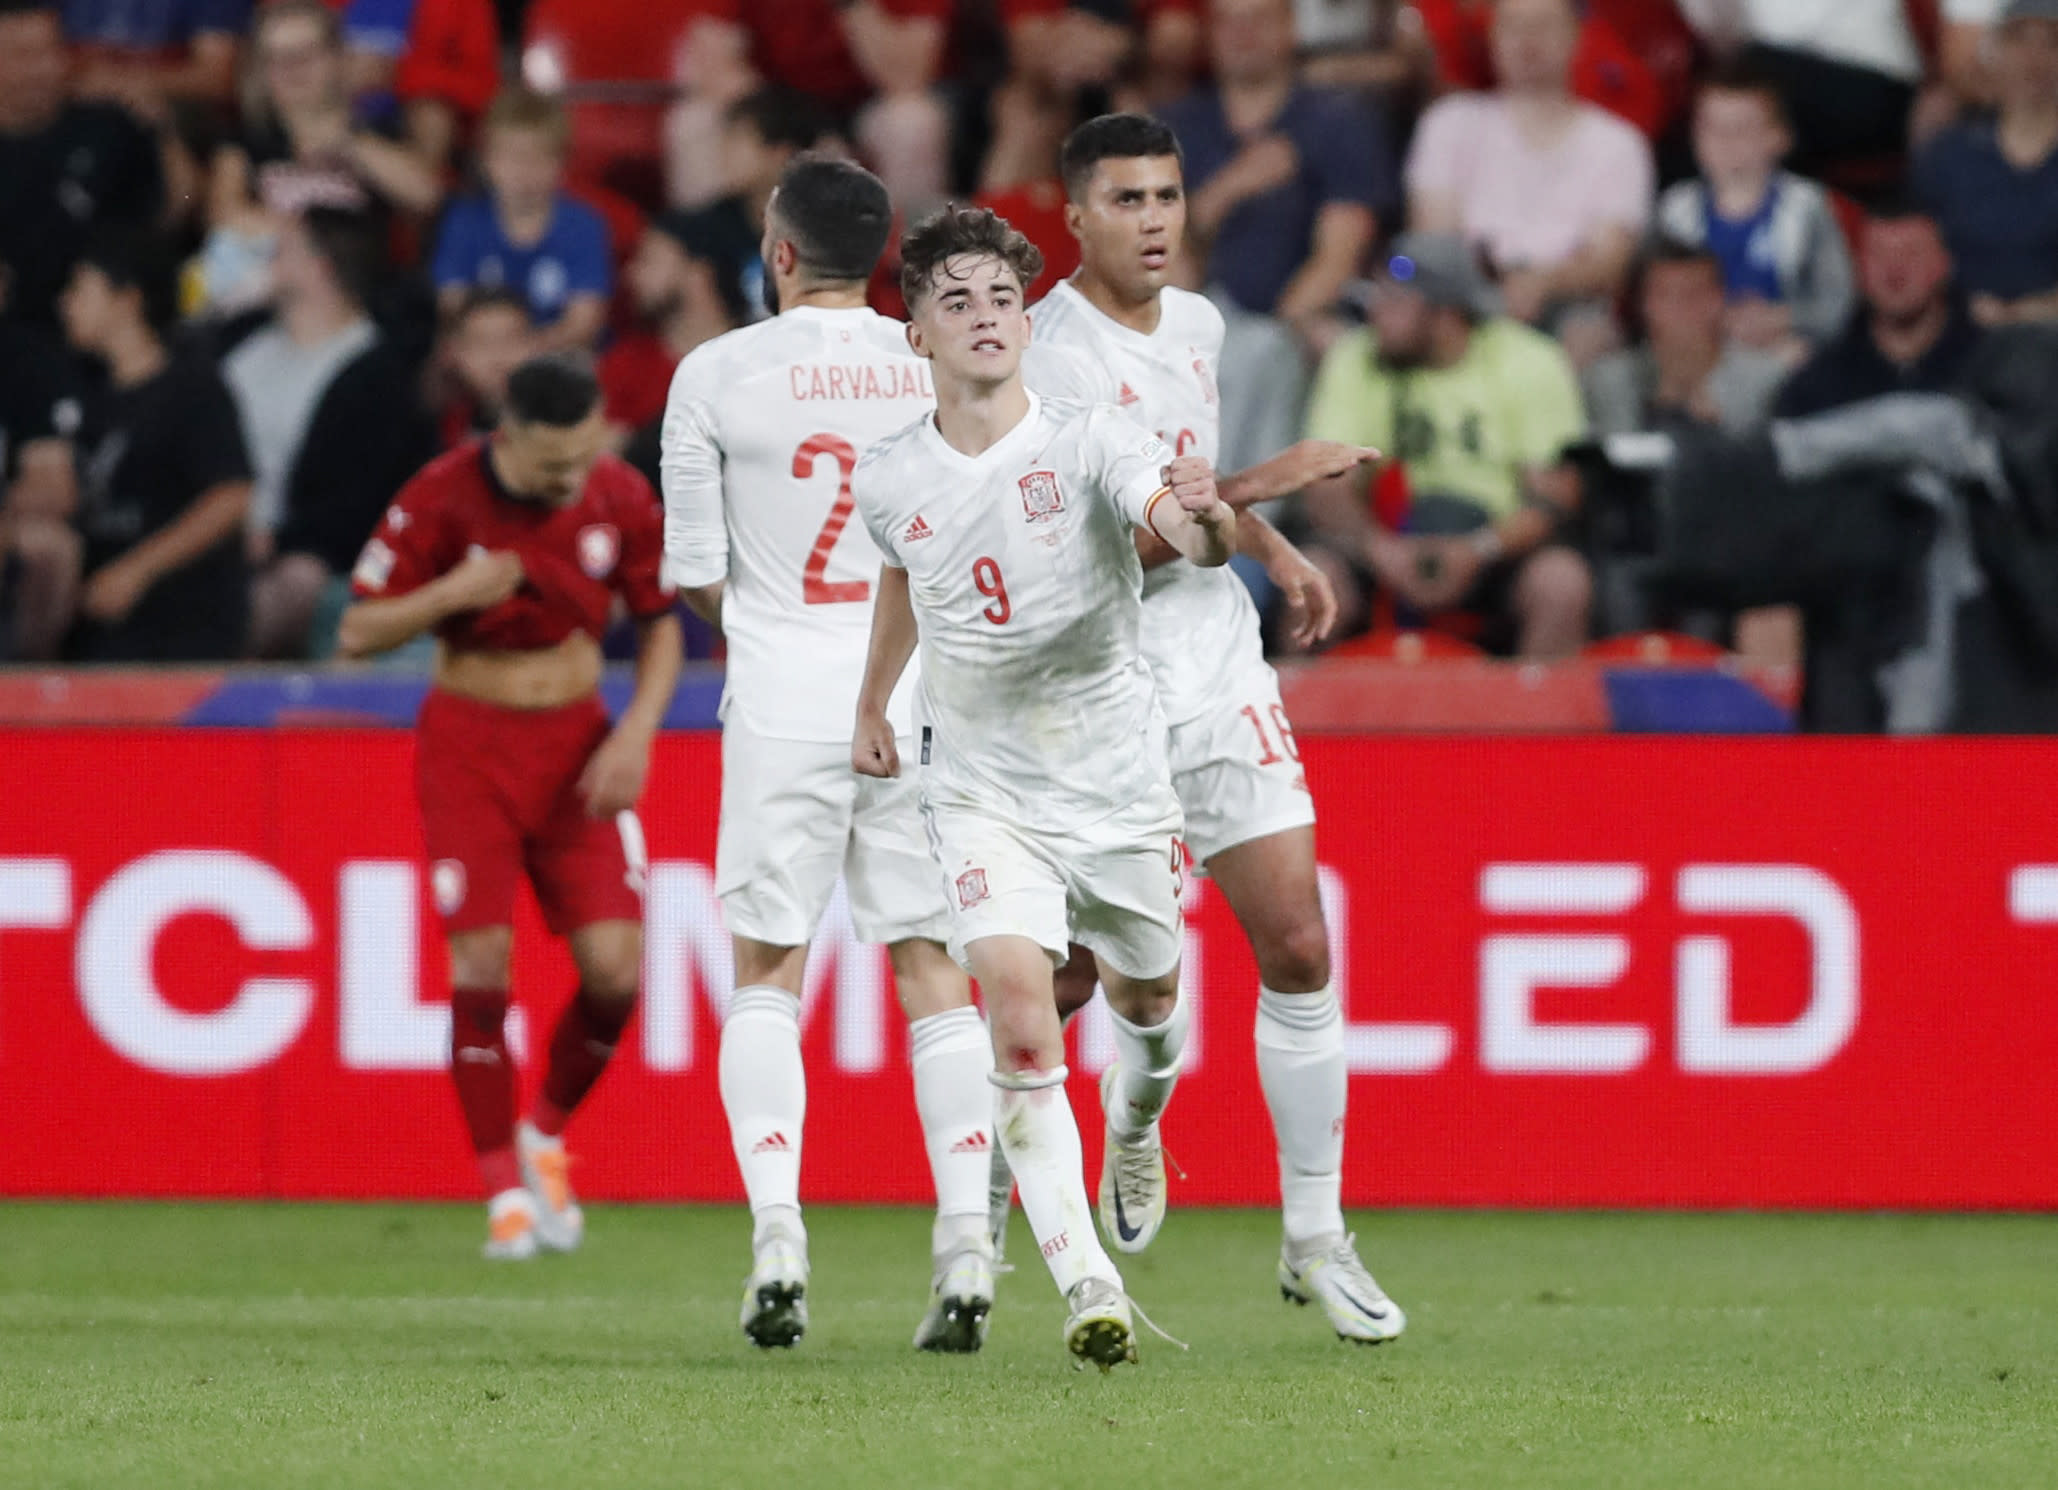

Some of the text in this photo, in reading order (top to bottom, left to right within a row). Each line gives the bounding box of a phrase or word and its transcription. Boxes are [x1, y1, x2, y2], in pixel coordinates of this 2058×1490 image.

[790, 363, 934, 400] CARVAJAL
[792, 432, 870, 605] 2
[972, 556, 1011, 625] 9
